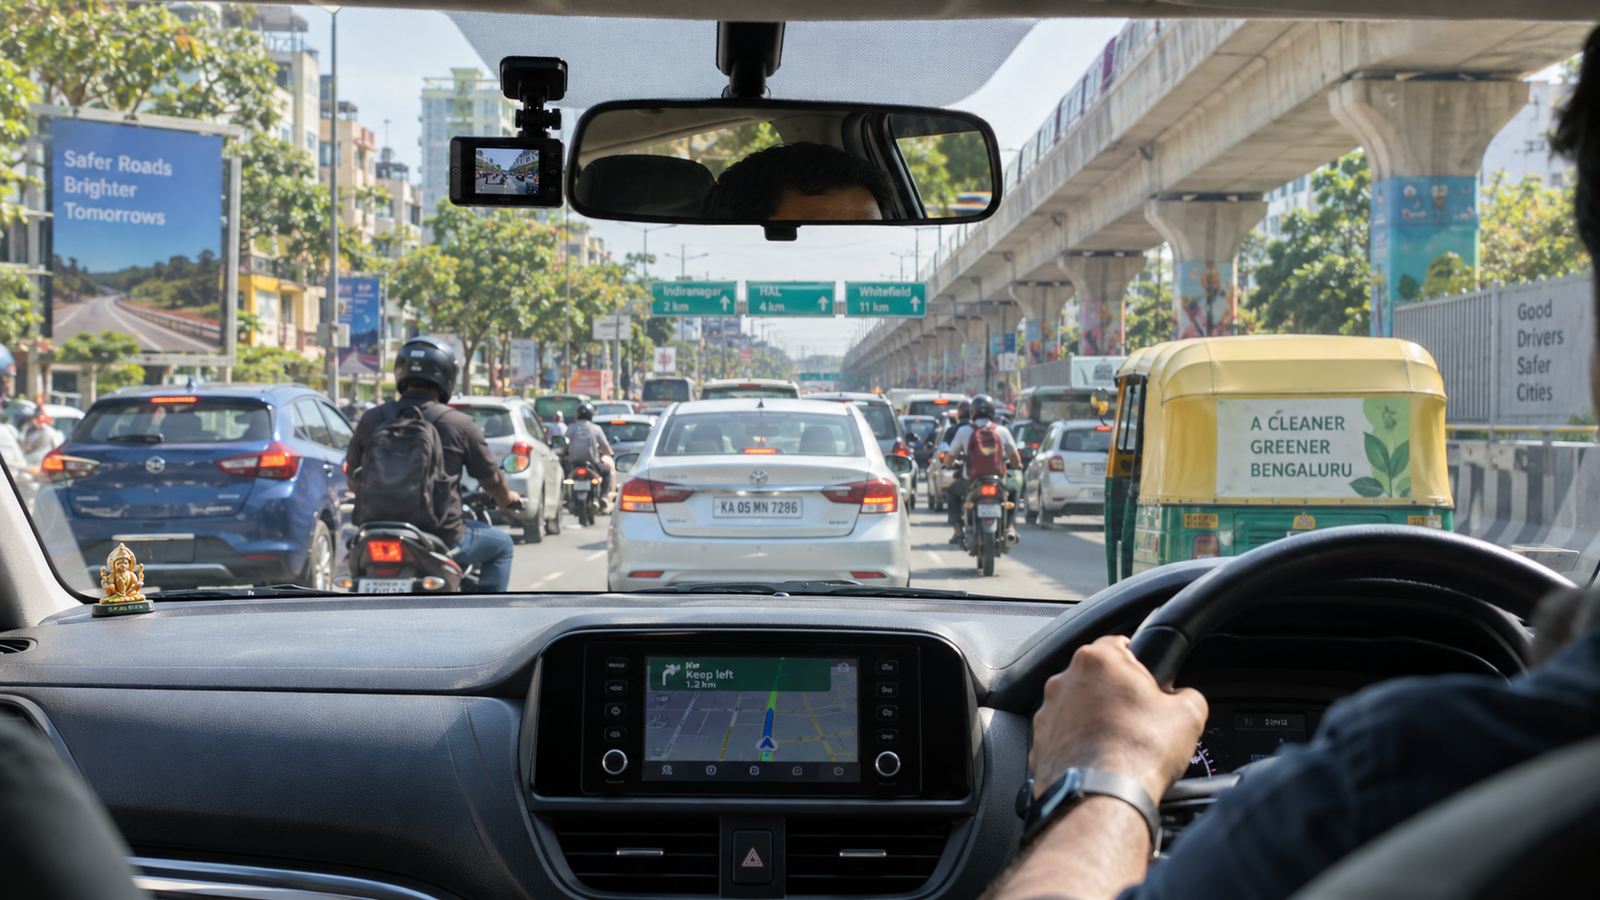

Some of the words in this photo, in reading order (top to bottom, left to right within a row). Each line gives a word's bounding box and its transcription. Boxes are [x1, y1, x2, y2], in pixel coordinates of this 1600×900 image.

[64, 150, 113, 171] Safer
[118, 155, 173, 177] Roads
[64, 176, 138, 199] Brighter
[64, 202, 166, 225] Tomorrows
[663, 286, 722, 298] Indiranagar
[760, 286, 782, 297] HAL
[859, 286, 911, 297] Whitefield
[663, 302, 670, 311] 2
[672, 301, 689, 312] km
[759, 302, 767, 312] 4
[768, 301, 785, 312] km
[860, 302, 869, 312] 11
[872, 301, 889, 312] km
[1517, 299, 1552, 321] Good
[1517, 328, 1564, 348] Drivers
[1517, 355, 1552, 376] Safer
[1516, 383, 1553, 402] Cities
[1250, 416, 1262, 431] A
[1268, 415, 1345, 431] CLEANER
[1250, 440, 1330, 455] GREENER
[1250, 463, 1352, 477] BENGALURU
[721, 501, 735, 514] KA
[737, 501, 751, 514] 05
[753, 501, 769, 514] MN
[771, 501, 798, 514] 7286
[716, 669, 734, 679] left
